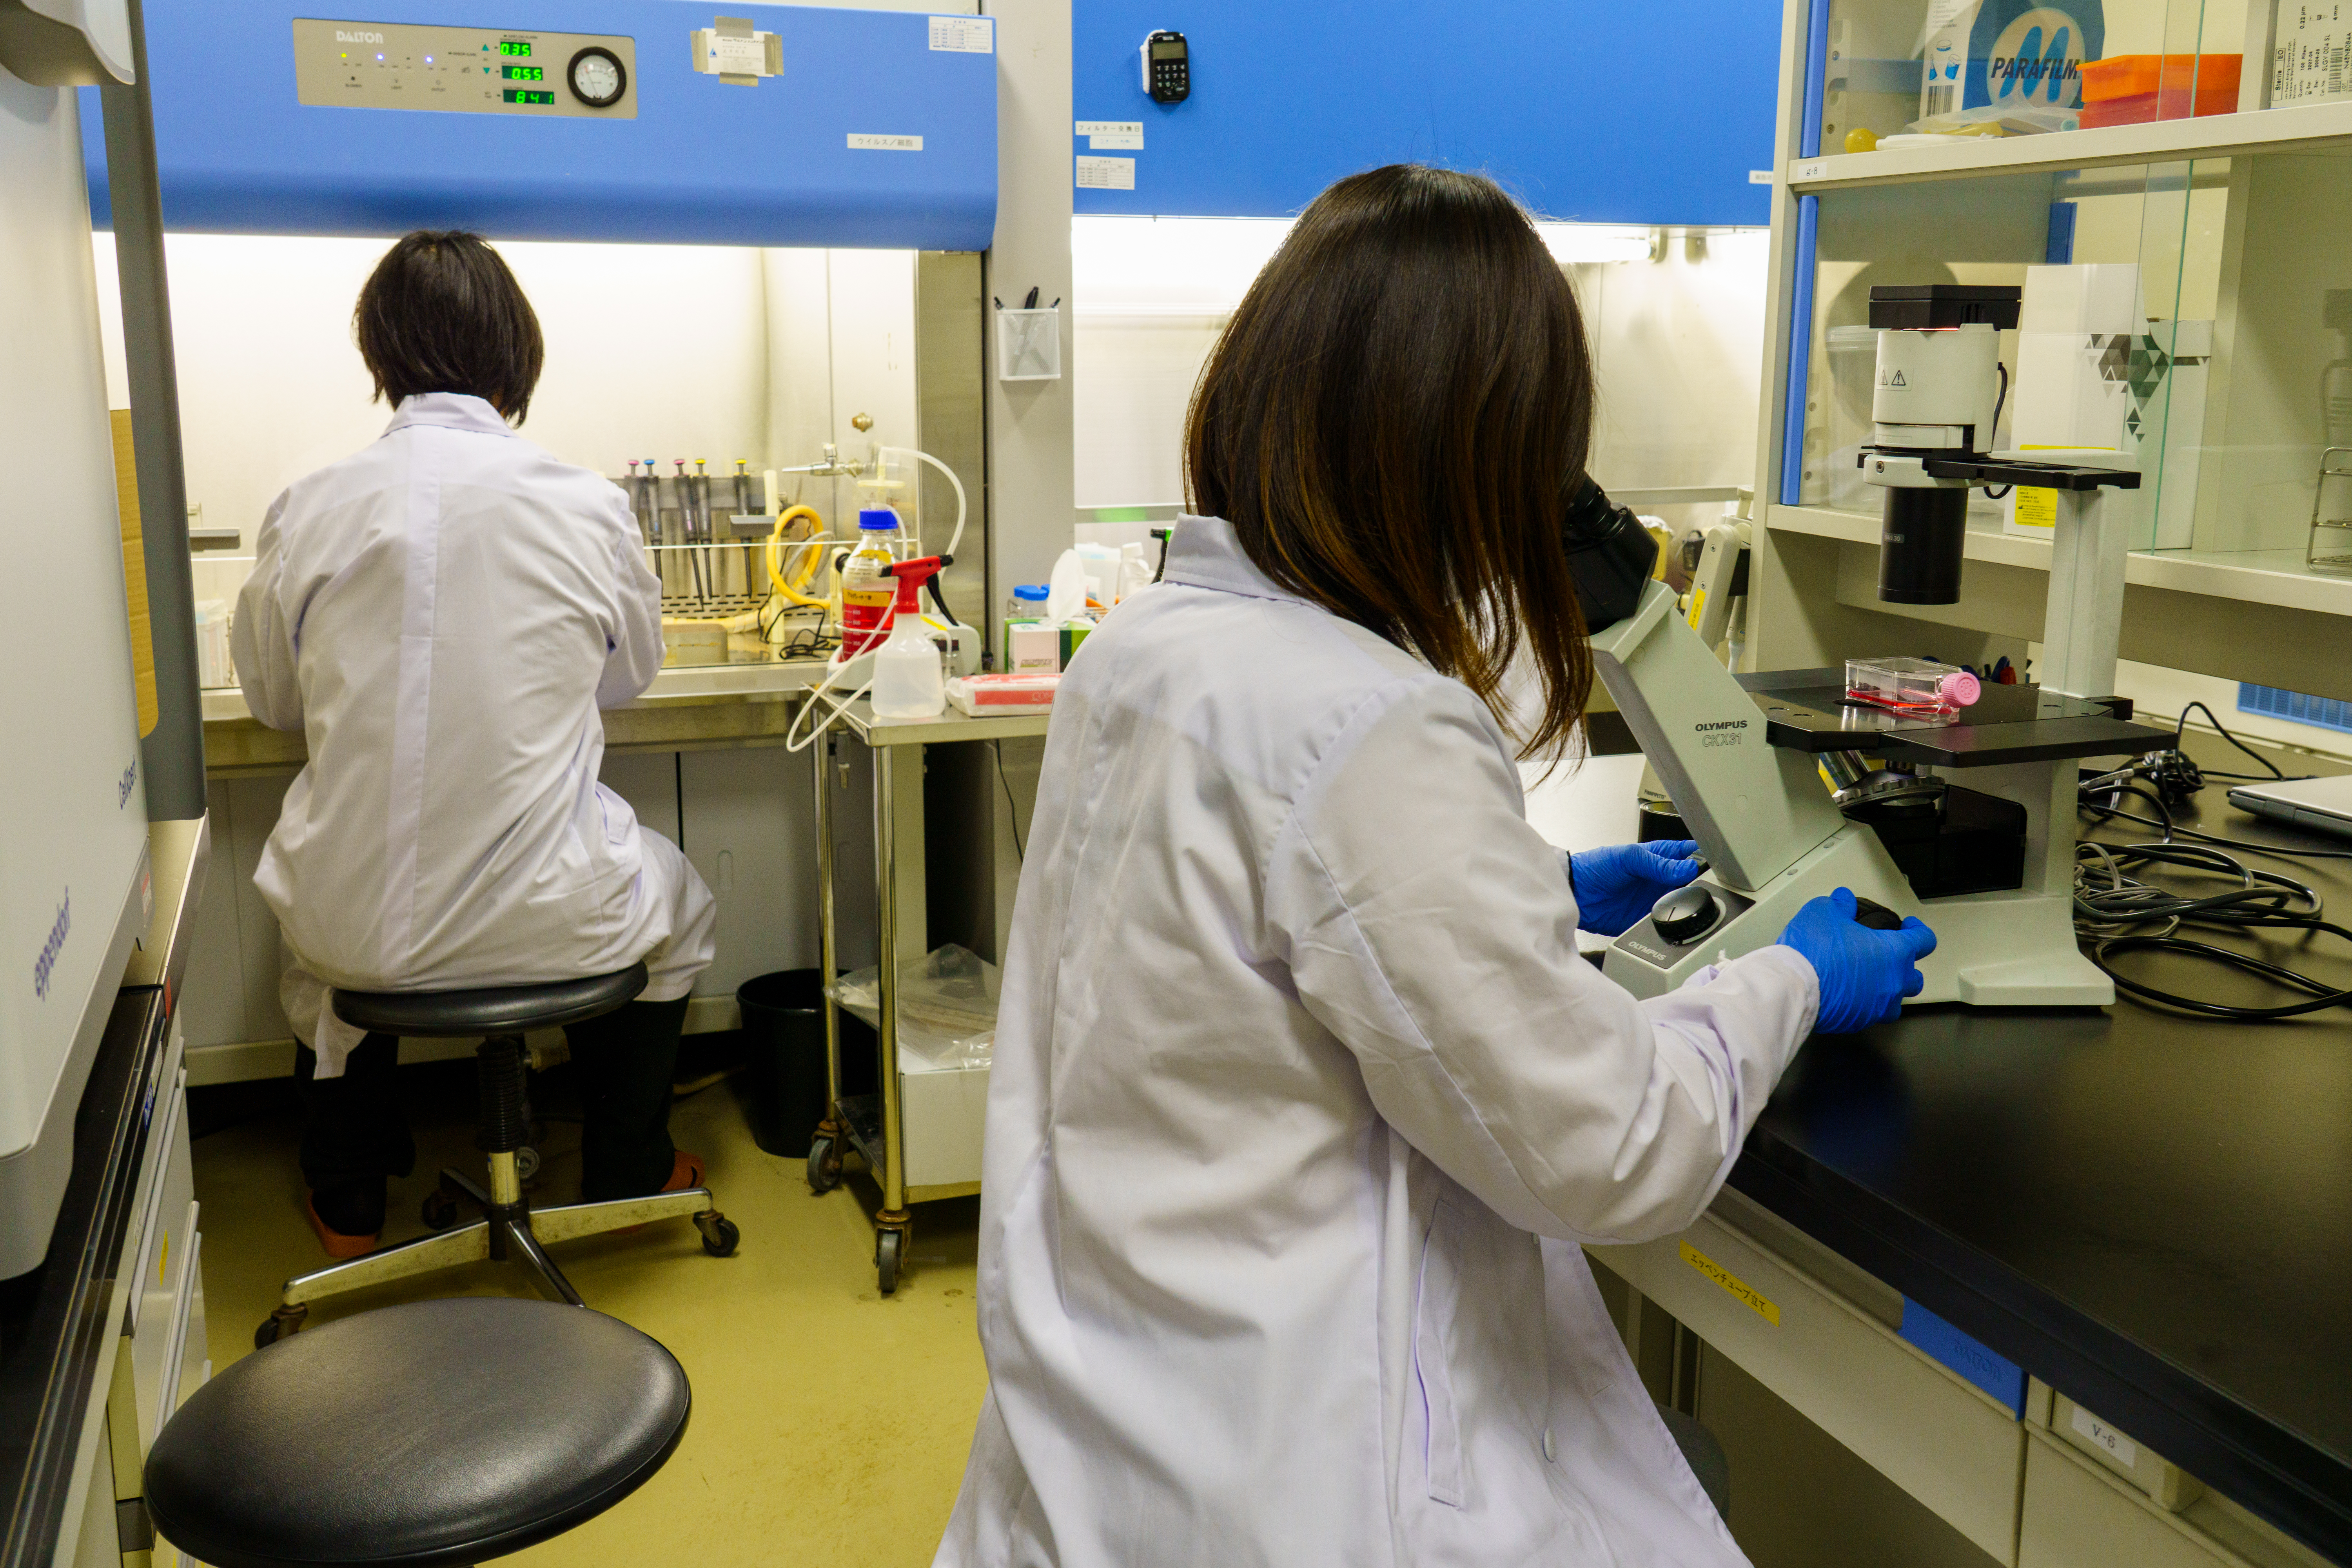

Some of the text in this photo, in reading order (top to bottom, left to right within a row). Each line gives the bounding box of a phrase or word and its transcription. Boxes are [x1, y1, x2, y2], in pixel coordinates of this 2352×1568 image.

[336, 31, 383, 44] DALTON
[500, 43, 530, 56] 0.35
[2278, 50, 2284, 59] EO
[512, 67, 542, 81] 0.55
[1991, 57, 2080, 80] PARAFILM
[1806, 167, 1817, 176] g-8
[1695, 720, 1748, 731] OLYMPUS
[1702, 733, 1741, 747] CKX31
[35, 885, 70, 1003] eppendorf
[1628, 941, 1666, 960] OLYMPUS
[2093, 1424, 2115, 1448] V-6
